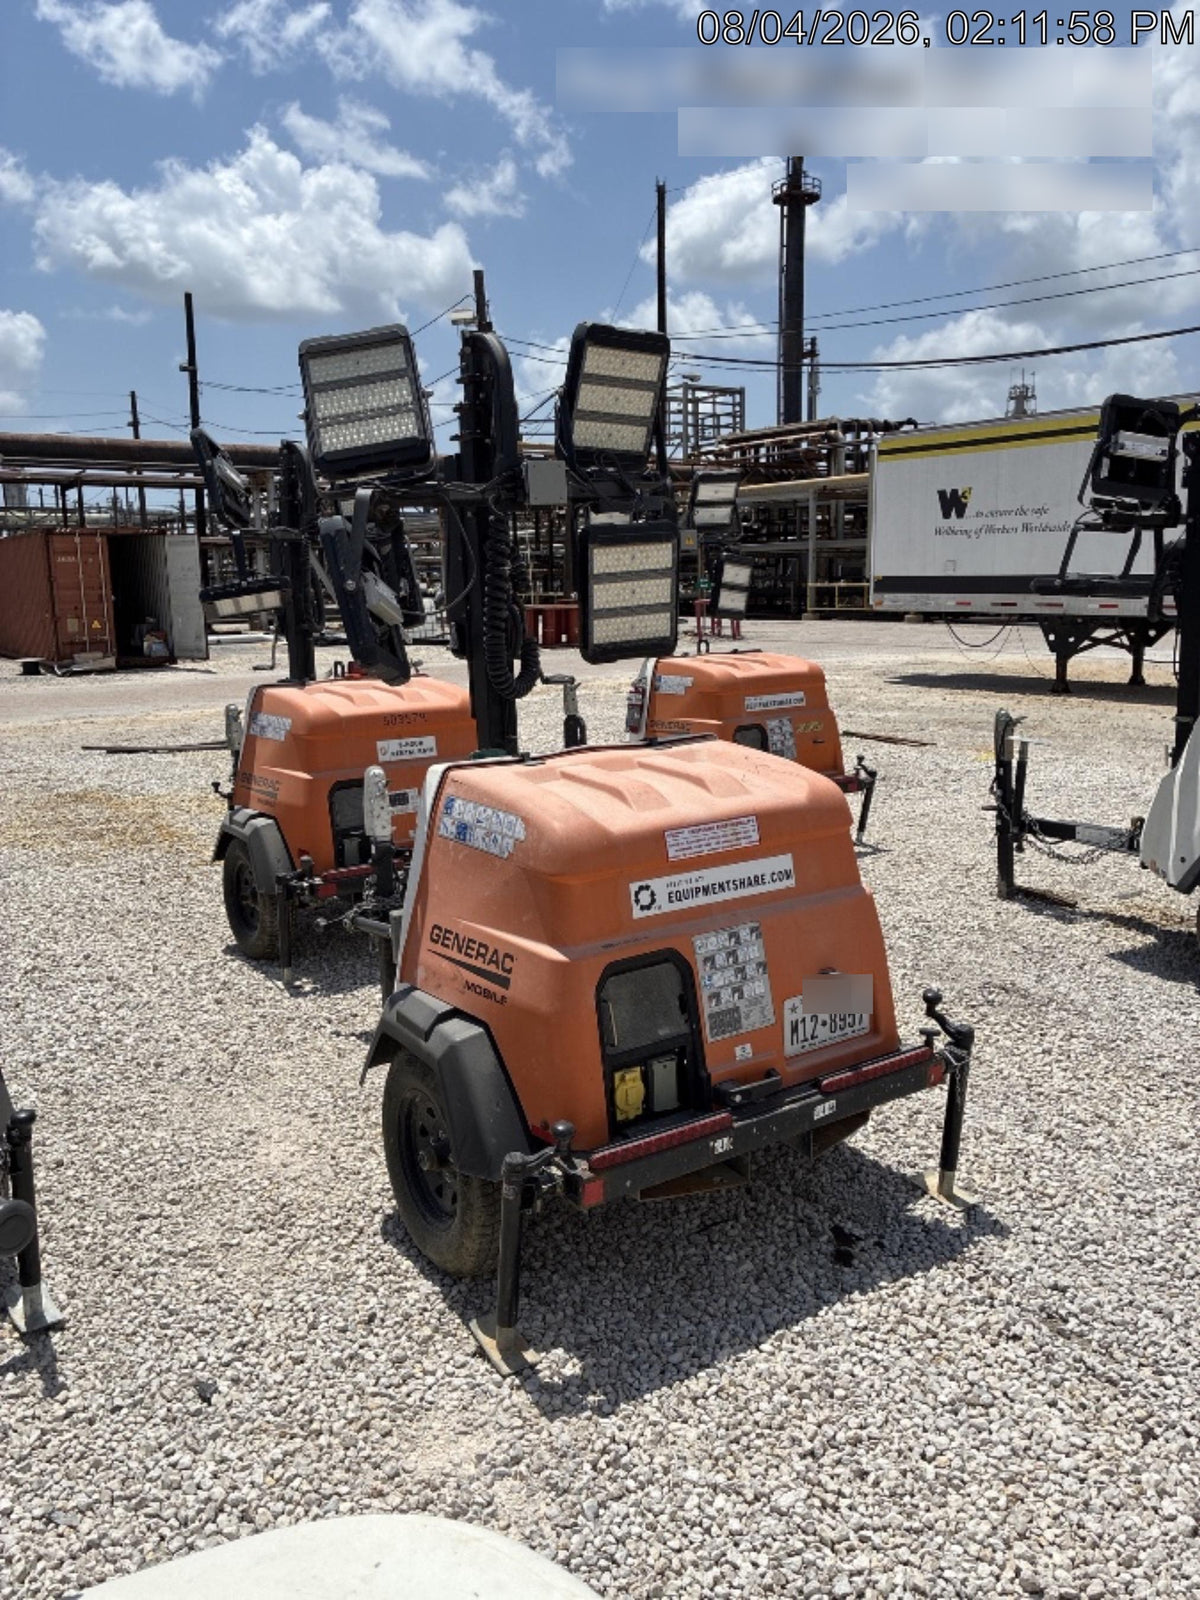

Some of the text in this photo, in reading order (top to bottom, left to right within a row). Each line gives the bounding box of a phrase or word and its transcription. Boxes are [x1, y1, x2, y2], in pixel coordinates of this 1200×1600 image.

[667, 869, 793, 904] EQUIPMENTSHARE.COM
[430, 924, 515, 975] GENERAC
[463, 980, 507, 1006] MOBILE
